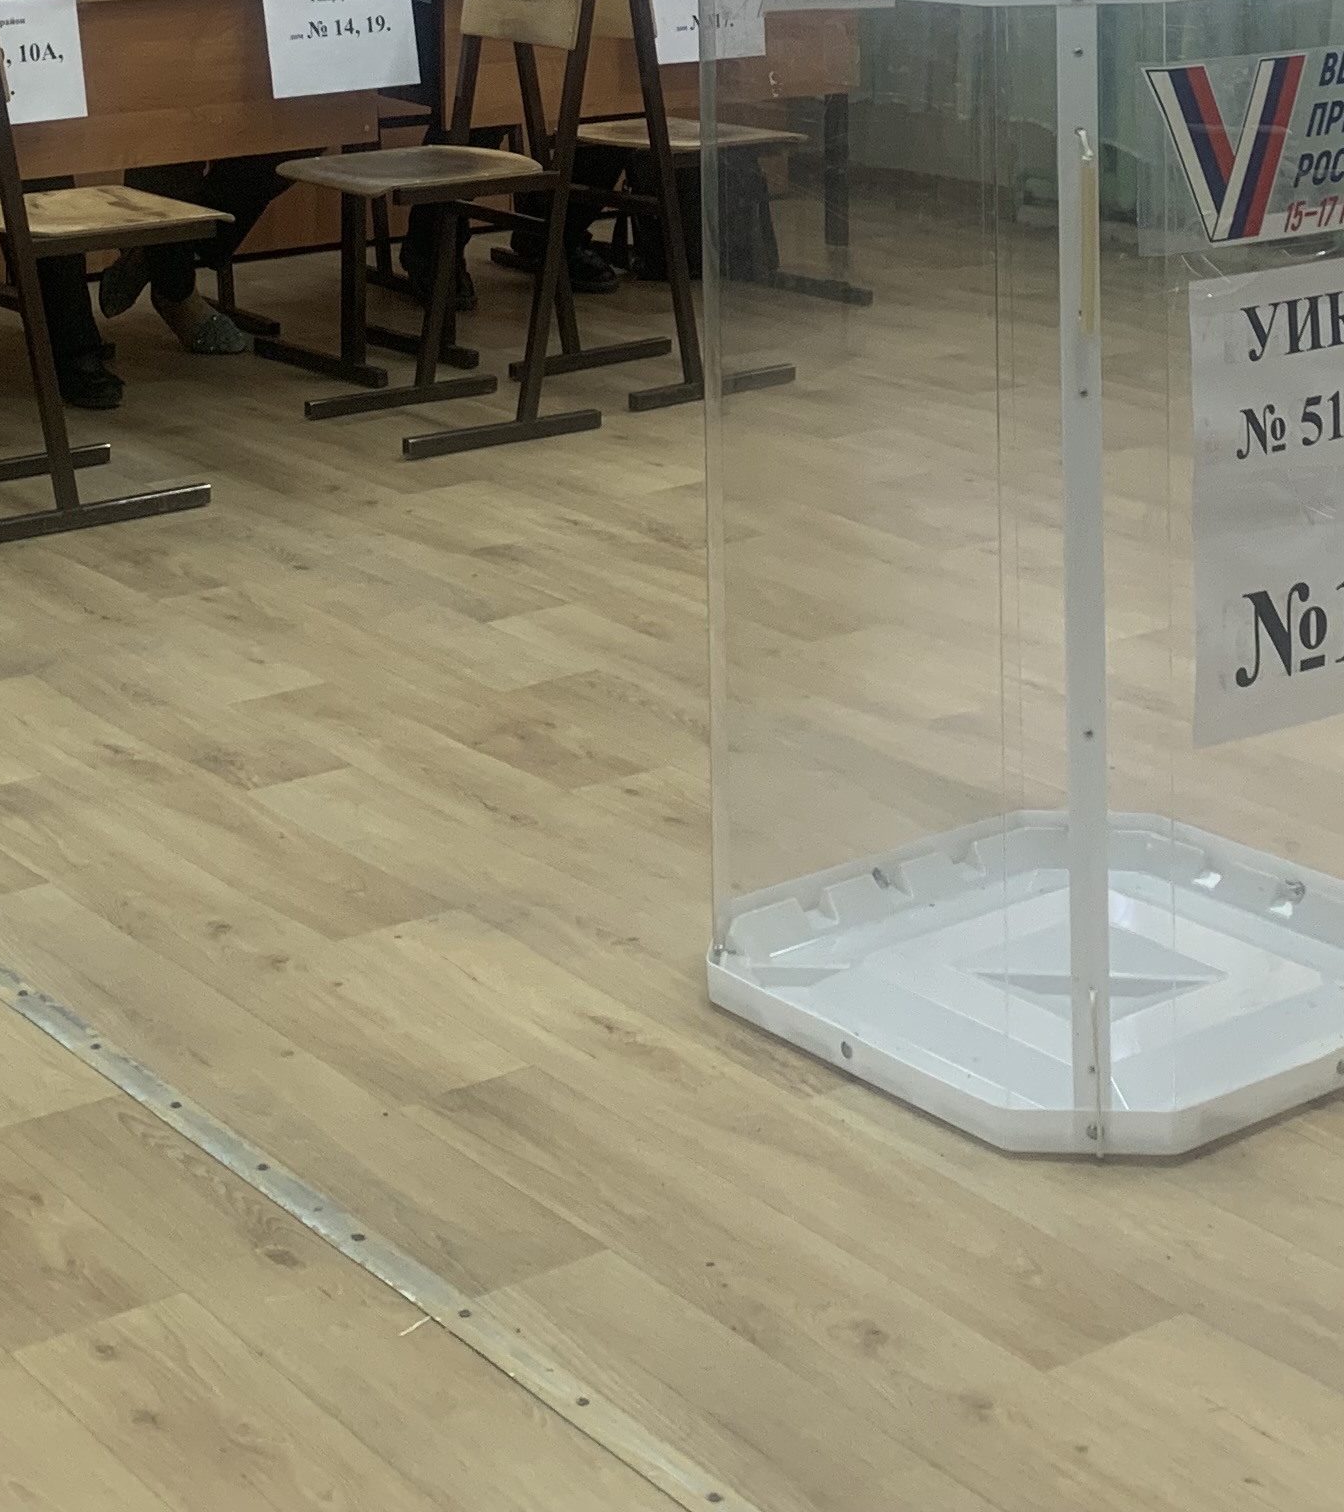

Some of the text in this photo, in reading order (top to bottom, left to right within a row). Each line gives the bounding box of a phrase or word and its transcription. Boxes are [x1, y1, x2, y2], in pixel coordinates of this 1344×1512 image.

[307, 20, 328, 39] №
[335, 18, 361, 38] 14,
[366, 15, 392, 34] 19.
[19, 42, 64, 64] 10А,
[1236, 403, 1287, 460] №
